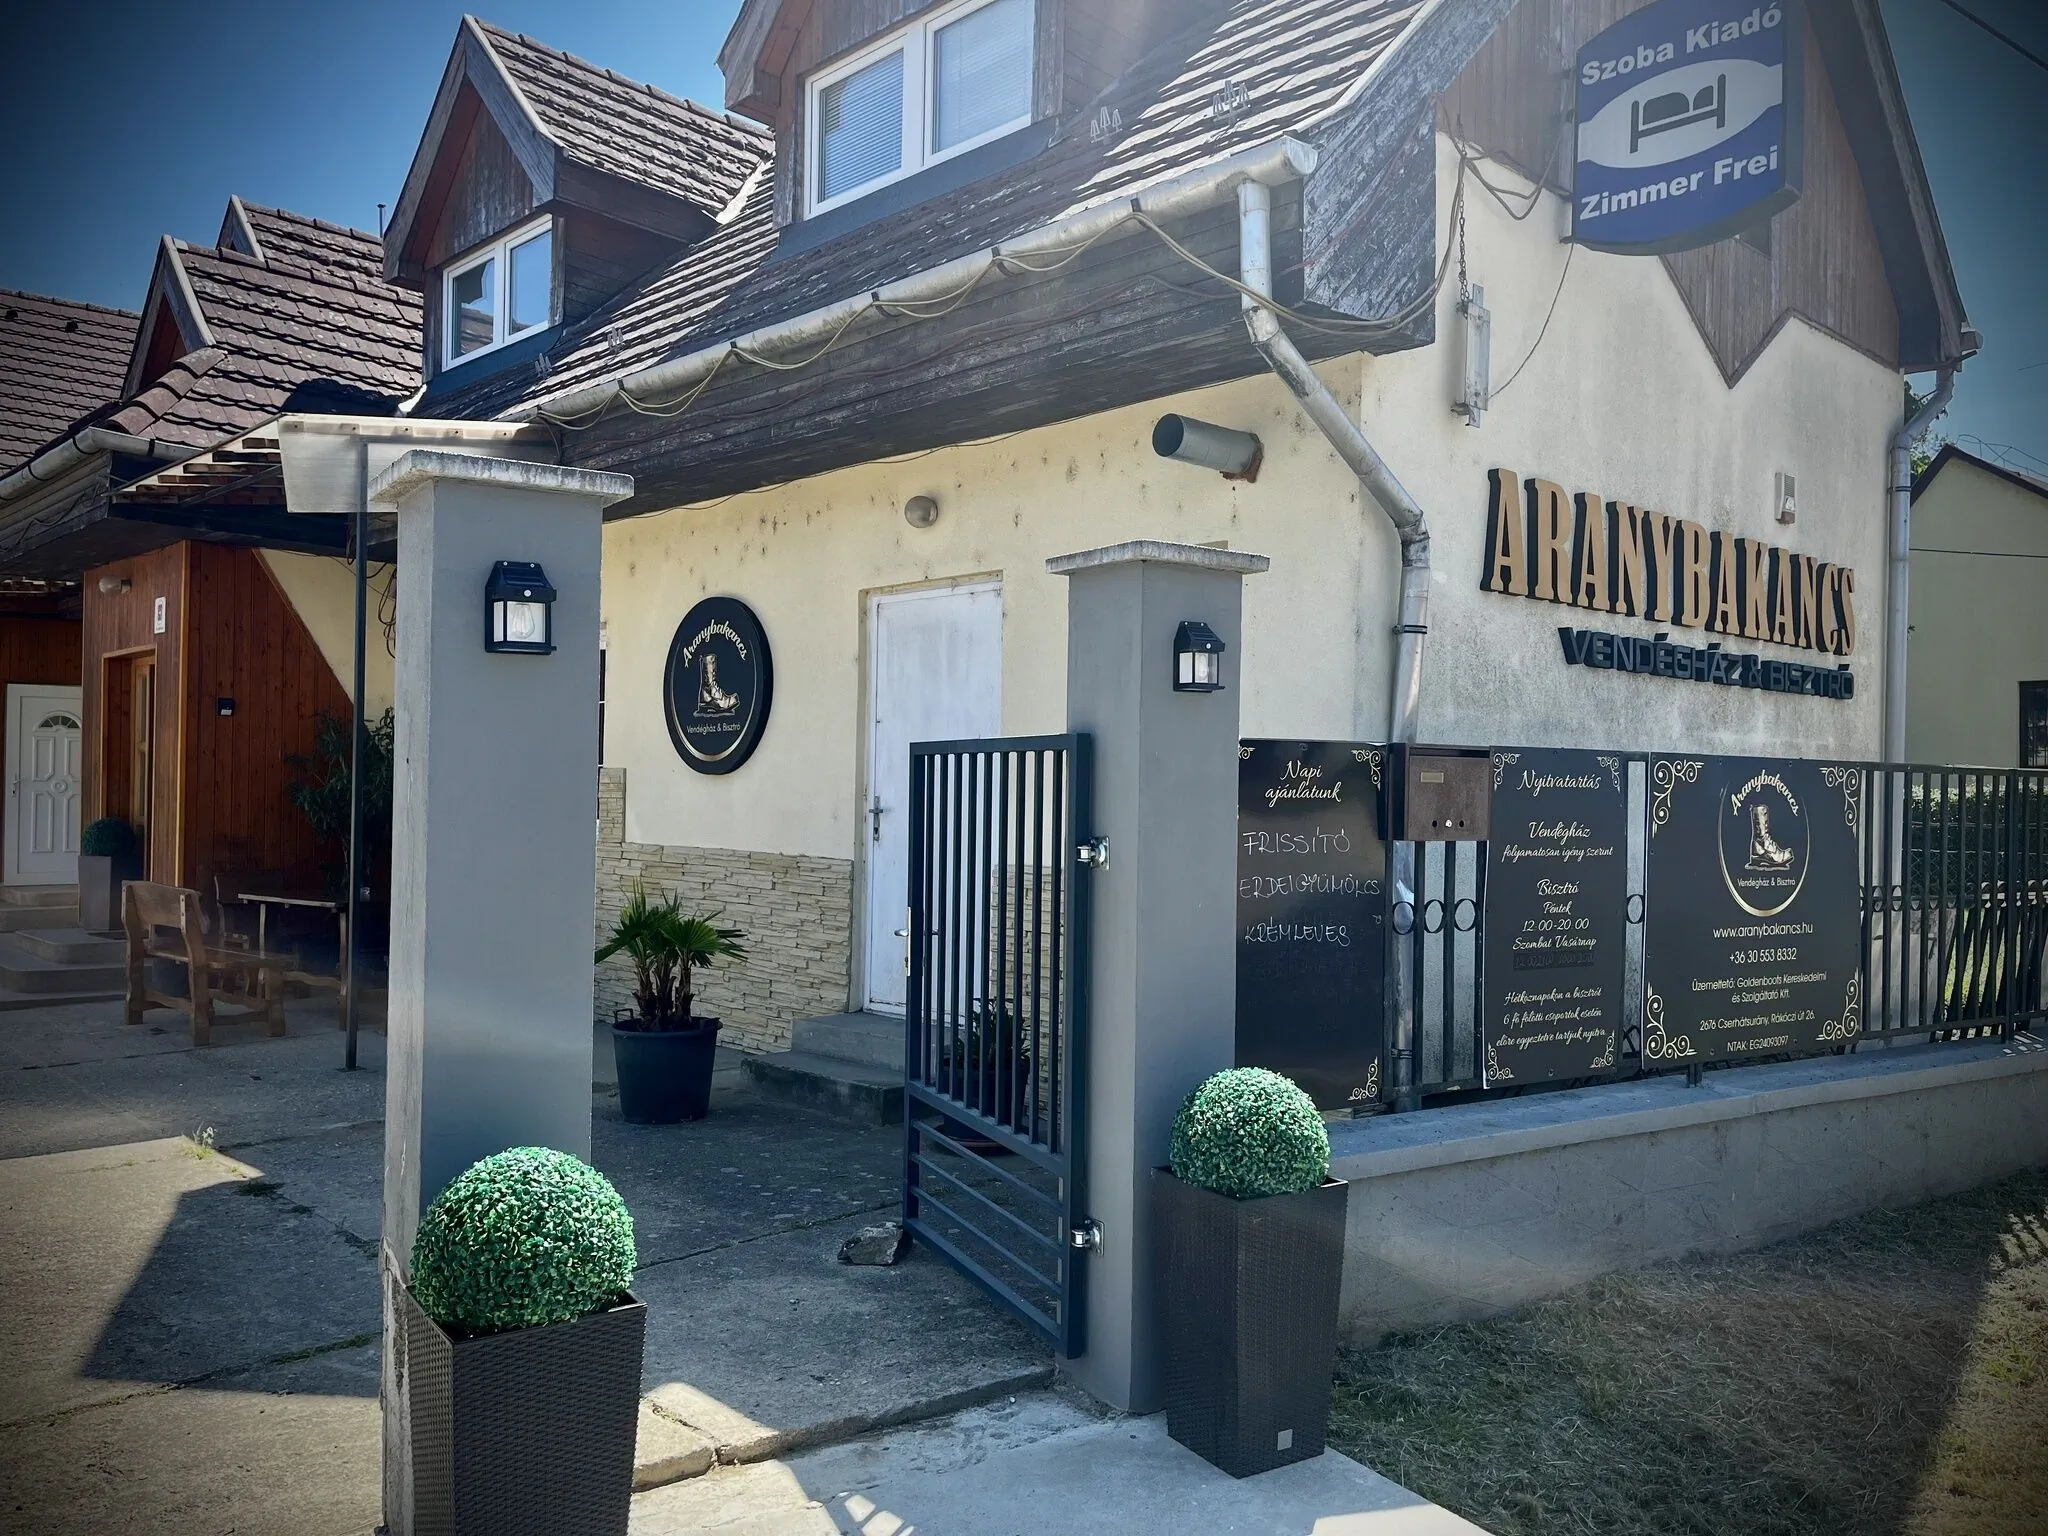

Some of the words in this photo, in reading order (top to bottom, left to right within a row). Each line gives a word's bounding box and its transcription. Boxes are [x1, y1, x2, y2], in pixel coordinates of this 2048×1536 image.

[1581, 45, 1675, 86] Szoba
[1686, 2, 1783, 53] Kiadó
[1579, 171, 1704, 221] Zimmer
[1713, 145, 1778, 185] Frei
[1480, 468, 1855, 656] ARANYBAKANCS
[683, 618, 748, 668] Aranybakancs
[1558, 627, 1743, 686] VENDÉGHÁZ
[1746, 655, 1763, 688] &
[1763, 664, 1854, 699] BISZTRÓ
[686, 724, 716, 735] Vendégház
[717, 724, 722, 732] &
[722, 722, 741, 732] Bisztró
[1280, 760, 1323, 785] Napi
[1516, 769, 1602, 797] Nyitvatartás
[1731, 769, 1800, 816] Aranybakancs
[1265, 781, 1342, 807] ajánlatunk
[1528, 821, 1591, 845] Vendégház
[1501, 844, 1560, 863] folyamatosan
[1562, 846, 1584, 862] igény
[1586, 846, 1614, 857] szerint
[1536, 878, 1580, 895] Bisztró
[1737, 877, 1769, 889] Vendégház
[1771, 877, 1776, 886] &
[1776, 876, 1796, 886] Bisztró
[1543, 901, 1573, 915] Péntek
[1712, 921, 1813, 938] www.aranybakancs.hu
[1512, 936, 1552, 950] Szombat
[1555, 934, 1597, 950] Vasárnap
[1729, 951, 1746, 964] +36
[1747, 949, 1758, 963] 30
[1760, 948, 1775, 962] 553
[1776, 947, 1797, 961] 8332
[1737, 975, 1782, 988] Goldenboots
[1783, 971, 1827, 984] Kereskedelmi
[1731, 993, 1740, 1003] és
[1741, 989, 1779, 1003] Szolgáltató
[1503, 1013, 1510, 1025] 6
[1700, 1020, 1716, 1031] 2676
[1771, 1012, 1797, 1023] Rákóczi
[1727, 1040, 1748, 1052] NTAK:
